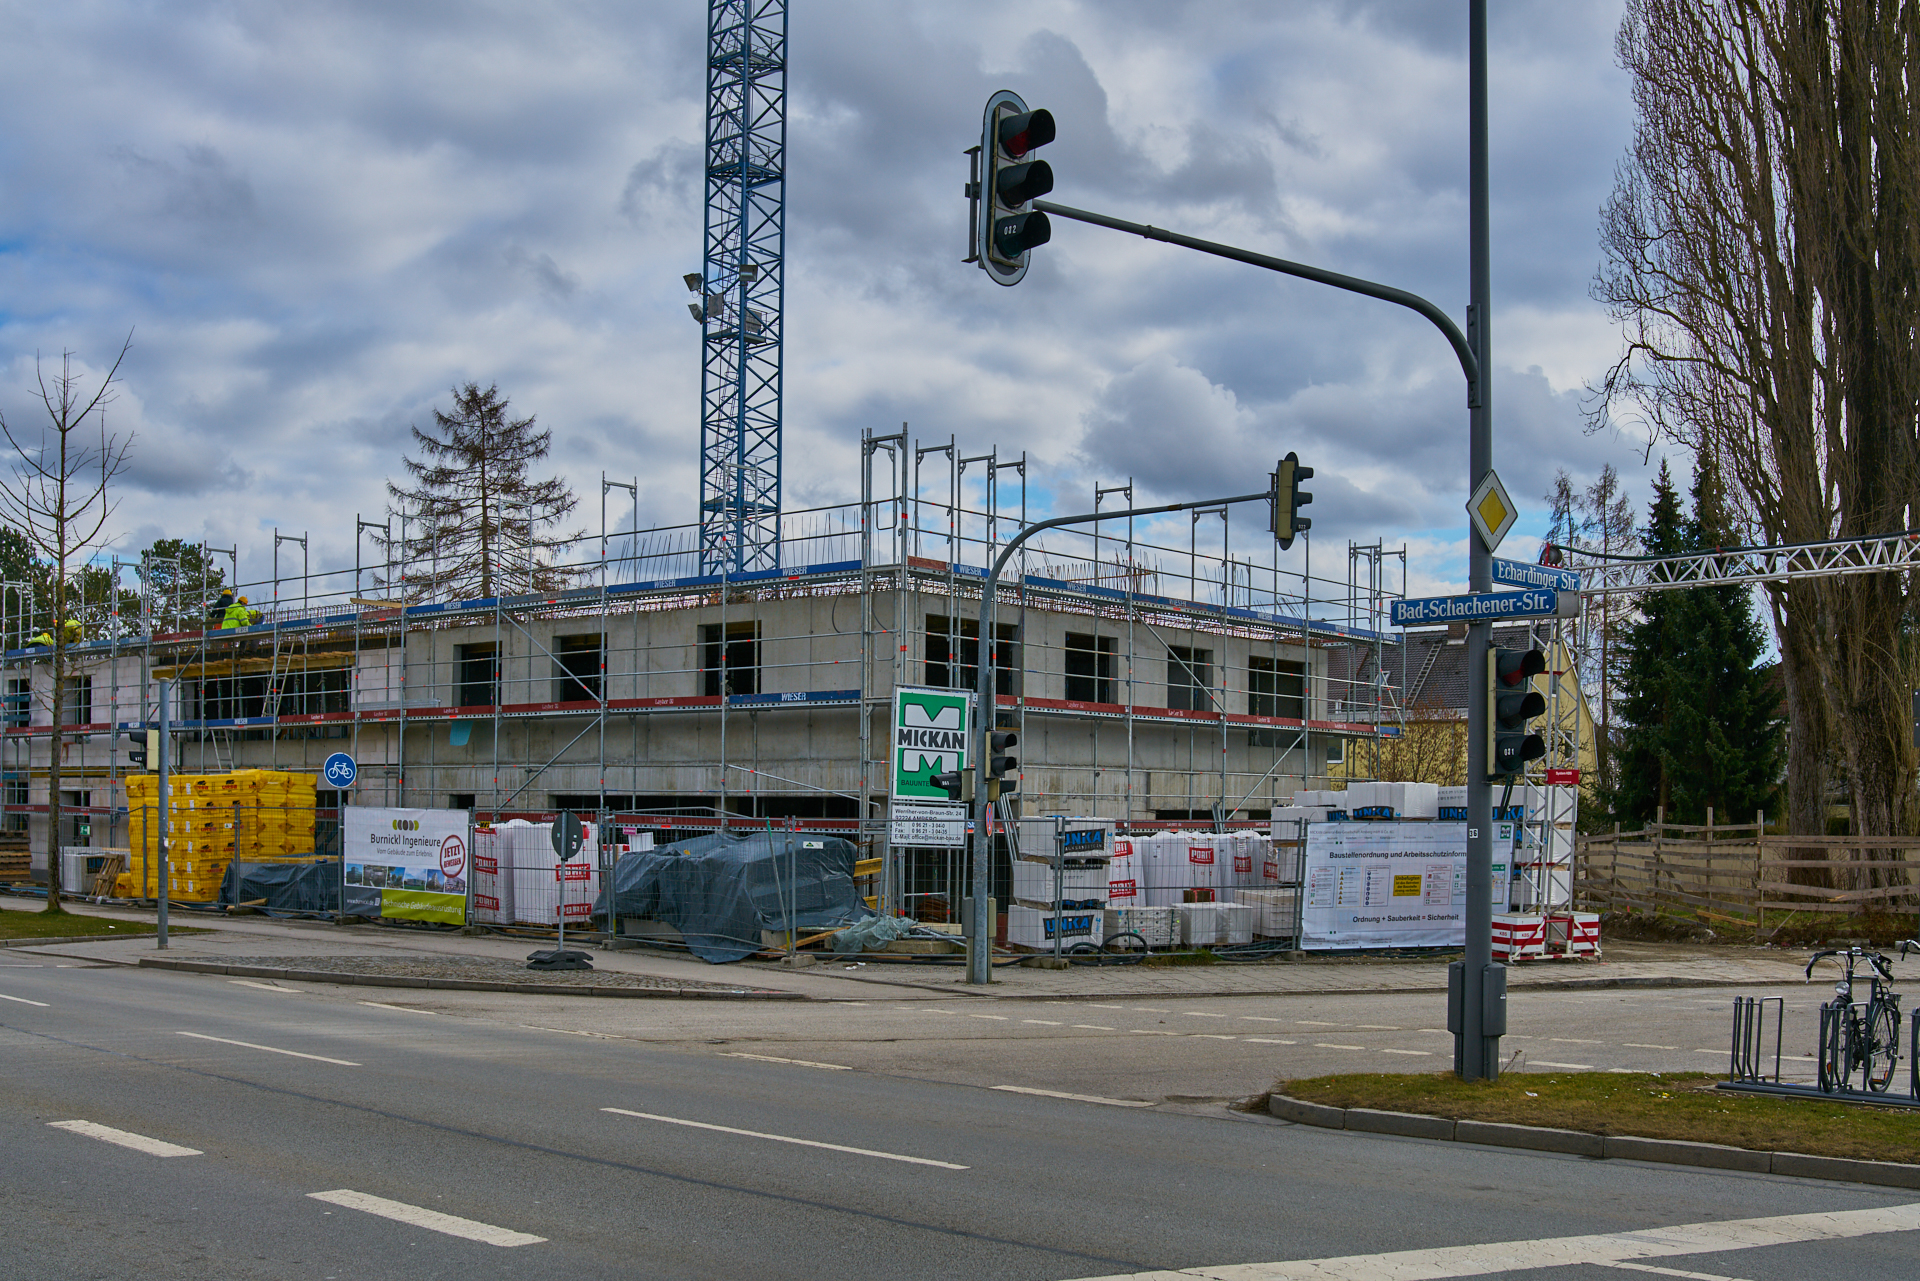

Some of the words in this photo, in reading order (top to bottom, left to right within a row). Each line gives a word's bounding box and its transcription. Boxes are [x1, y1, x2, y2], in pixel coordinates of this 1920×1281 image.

[782, 566, 807, 577] WIESER
[958, 564, 982, 576] WIESER
[1498, 560, 1558, 589] Echardinger
[1561, 573, 1577, 591] Str.
[653, 579, 676, 589] WIESER
[1066, 581, 1087, 593] WIESER
[443, 602, 462, 610] WIESER
[1397, 593, 1550, 620] Bad-Schachener-Str.
[782, 692, 806, 701] WIESER
[897, 728, 965, 750] MICKAN
[370, 833, 401, 845] Burnickl
[402, 835, 441, 848] Ingenieure
[387, 848, 406, 856] Gebäude
[444, 844, 460, 858] JETZT
[1329, 851, 1389, 860] Baustellenordnung
[383, 899, 410, 909] Technische
[410, 901, 462, 915] Gebäudeausrüstung
[1352, 916, 1381, 924] Ordnung
[1387, 914, 1421, 922] Sauberkeit
